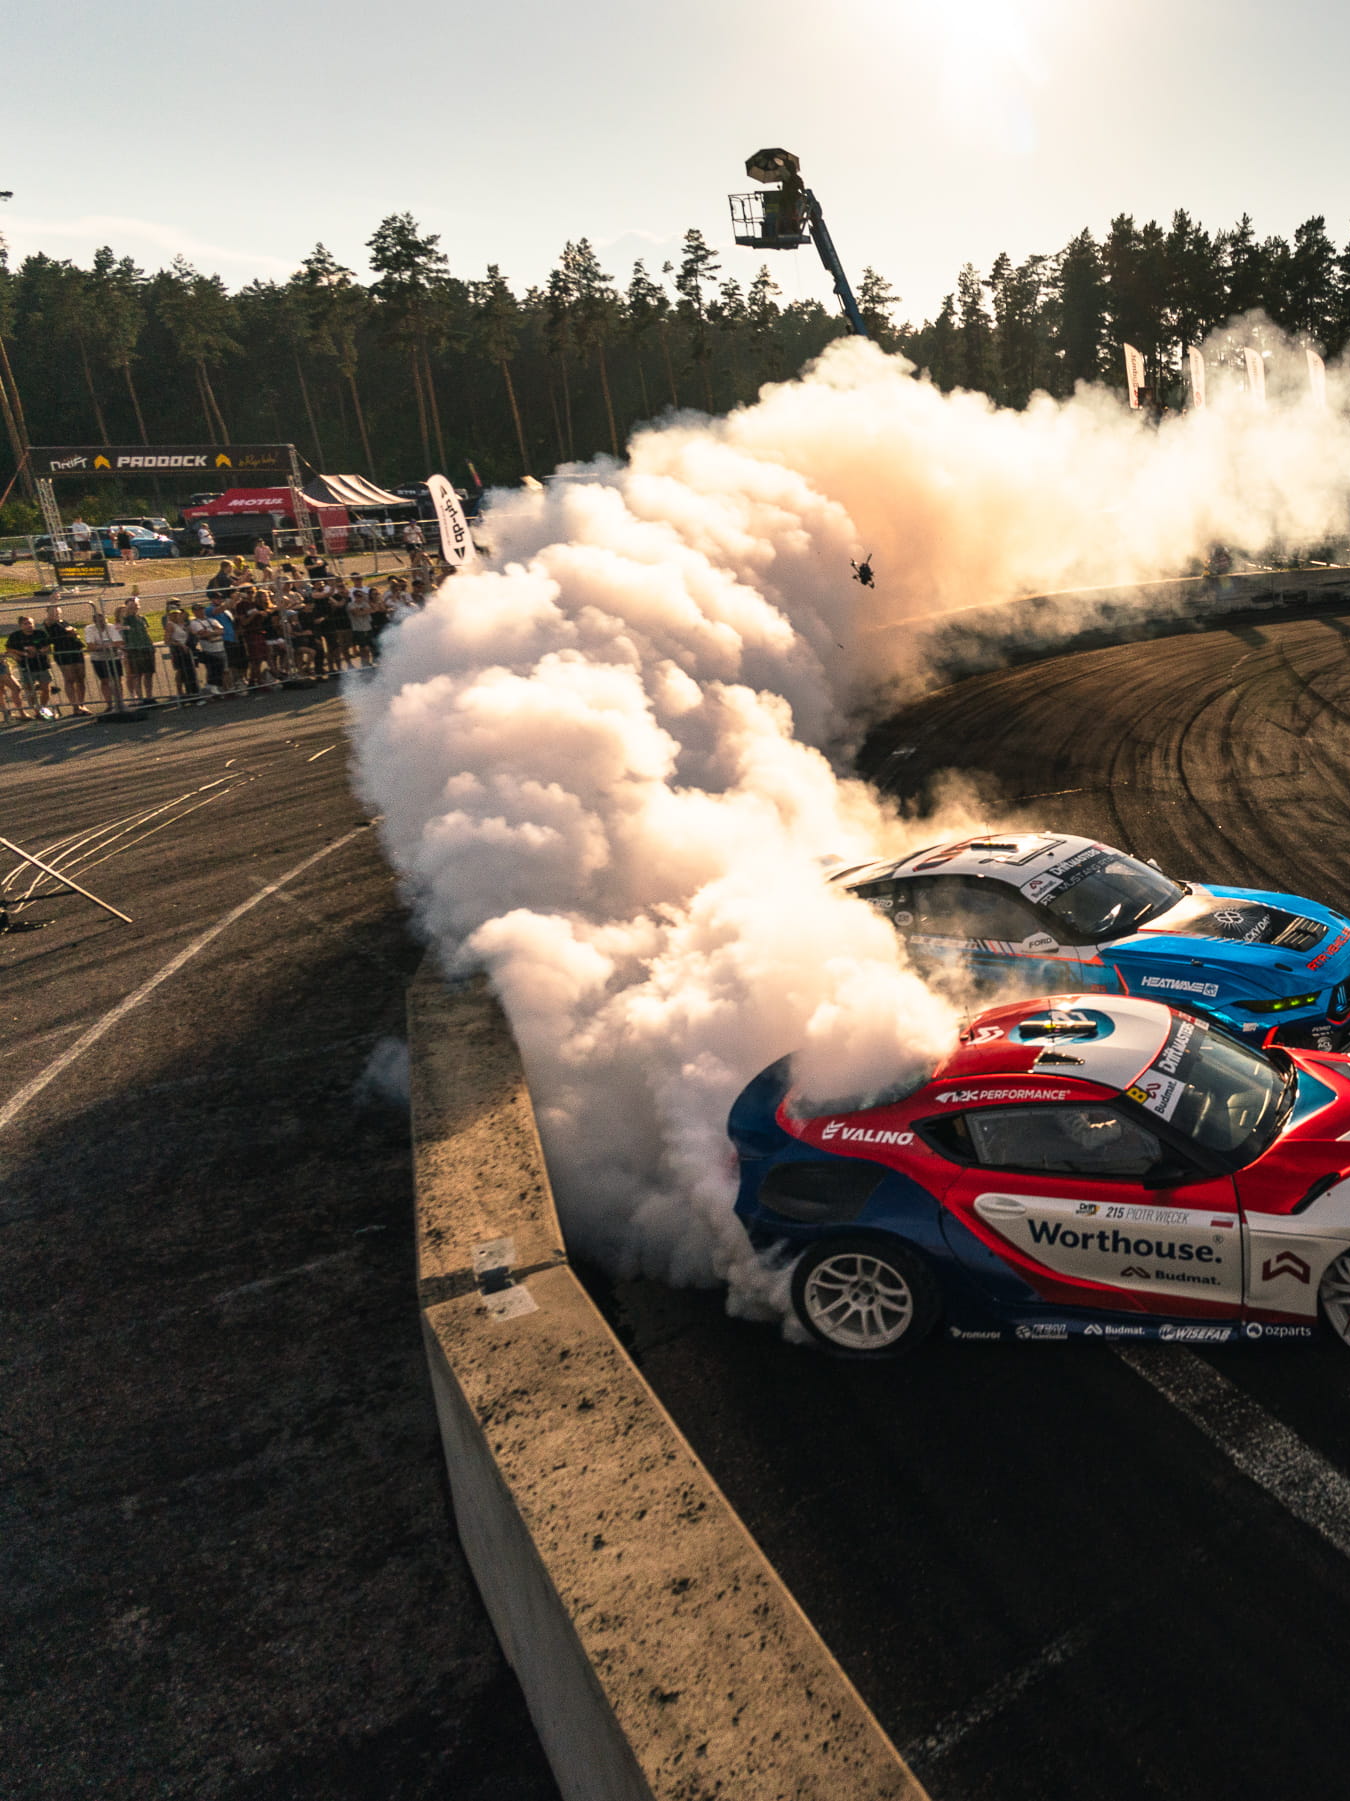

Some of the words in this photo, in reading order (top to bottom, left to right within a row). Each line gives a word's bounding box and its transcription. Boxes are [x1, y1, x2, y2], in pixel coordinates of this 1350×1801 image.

[117, 456, 207, 468] PADDOCK
[228, 498, 284, 507] MOTUL
[1028, 938, 1053, 949] FORD
[1141, 976, 1204, 993] HEATWAVE
[1126, 1087, 1149, 1104] B
[1154, 1080, 1178, 1114] Budmat.
[841, 1127, 914, 1146] VALINO
[1105, 1206, 1125, 1219] 215
[1155, 1269, 1222, 1286] Budmat.
[1105, 1325, 1146, 1336] Budmat.
[1175, 1326, 1232, 1341] WISEFAB
[1265, 1325, 1312, 1338] ozparts
